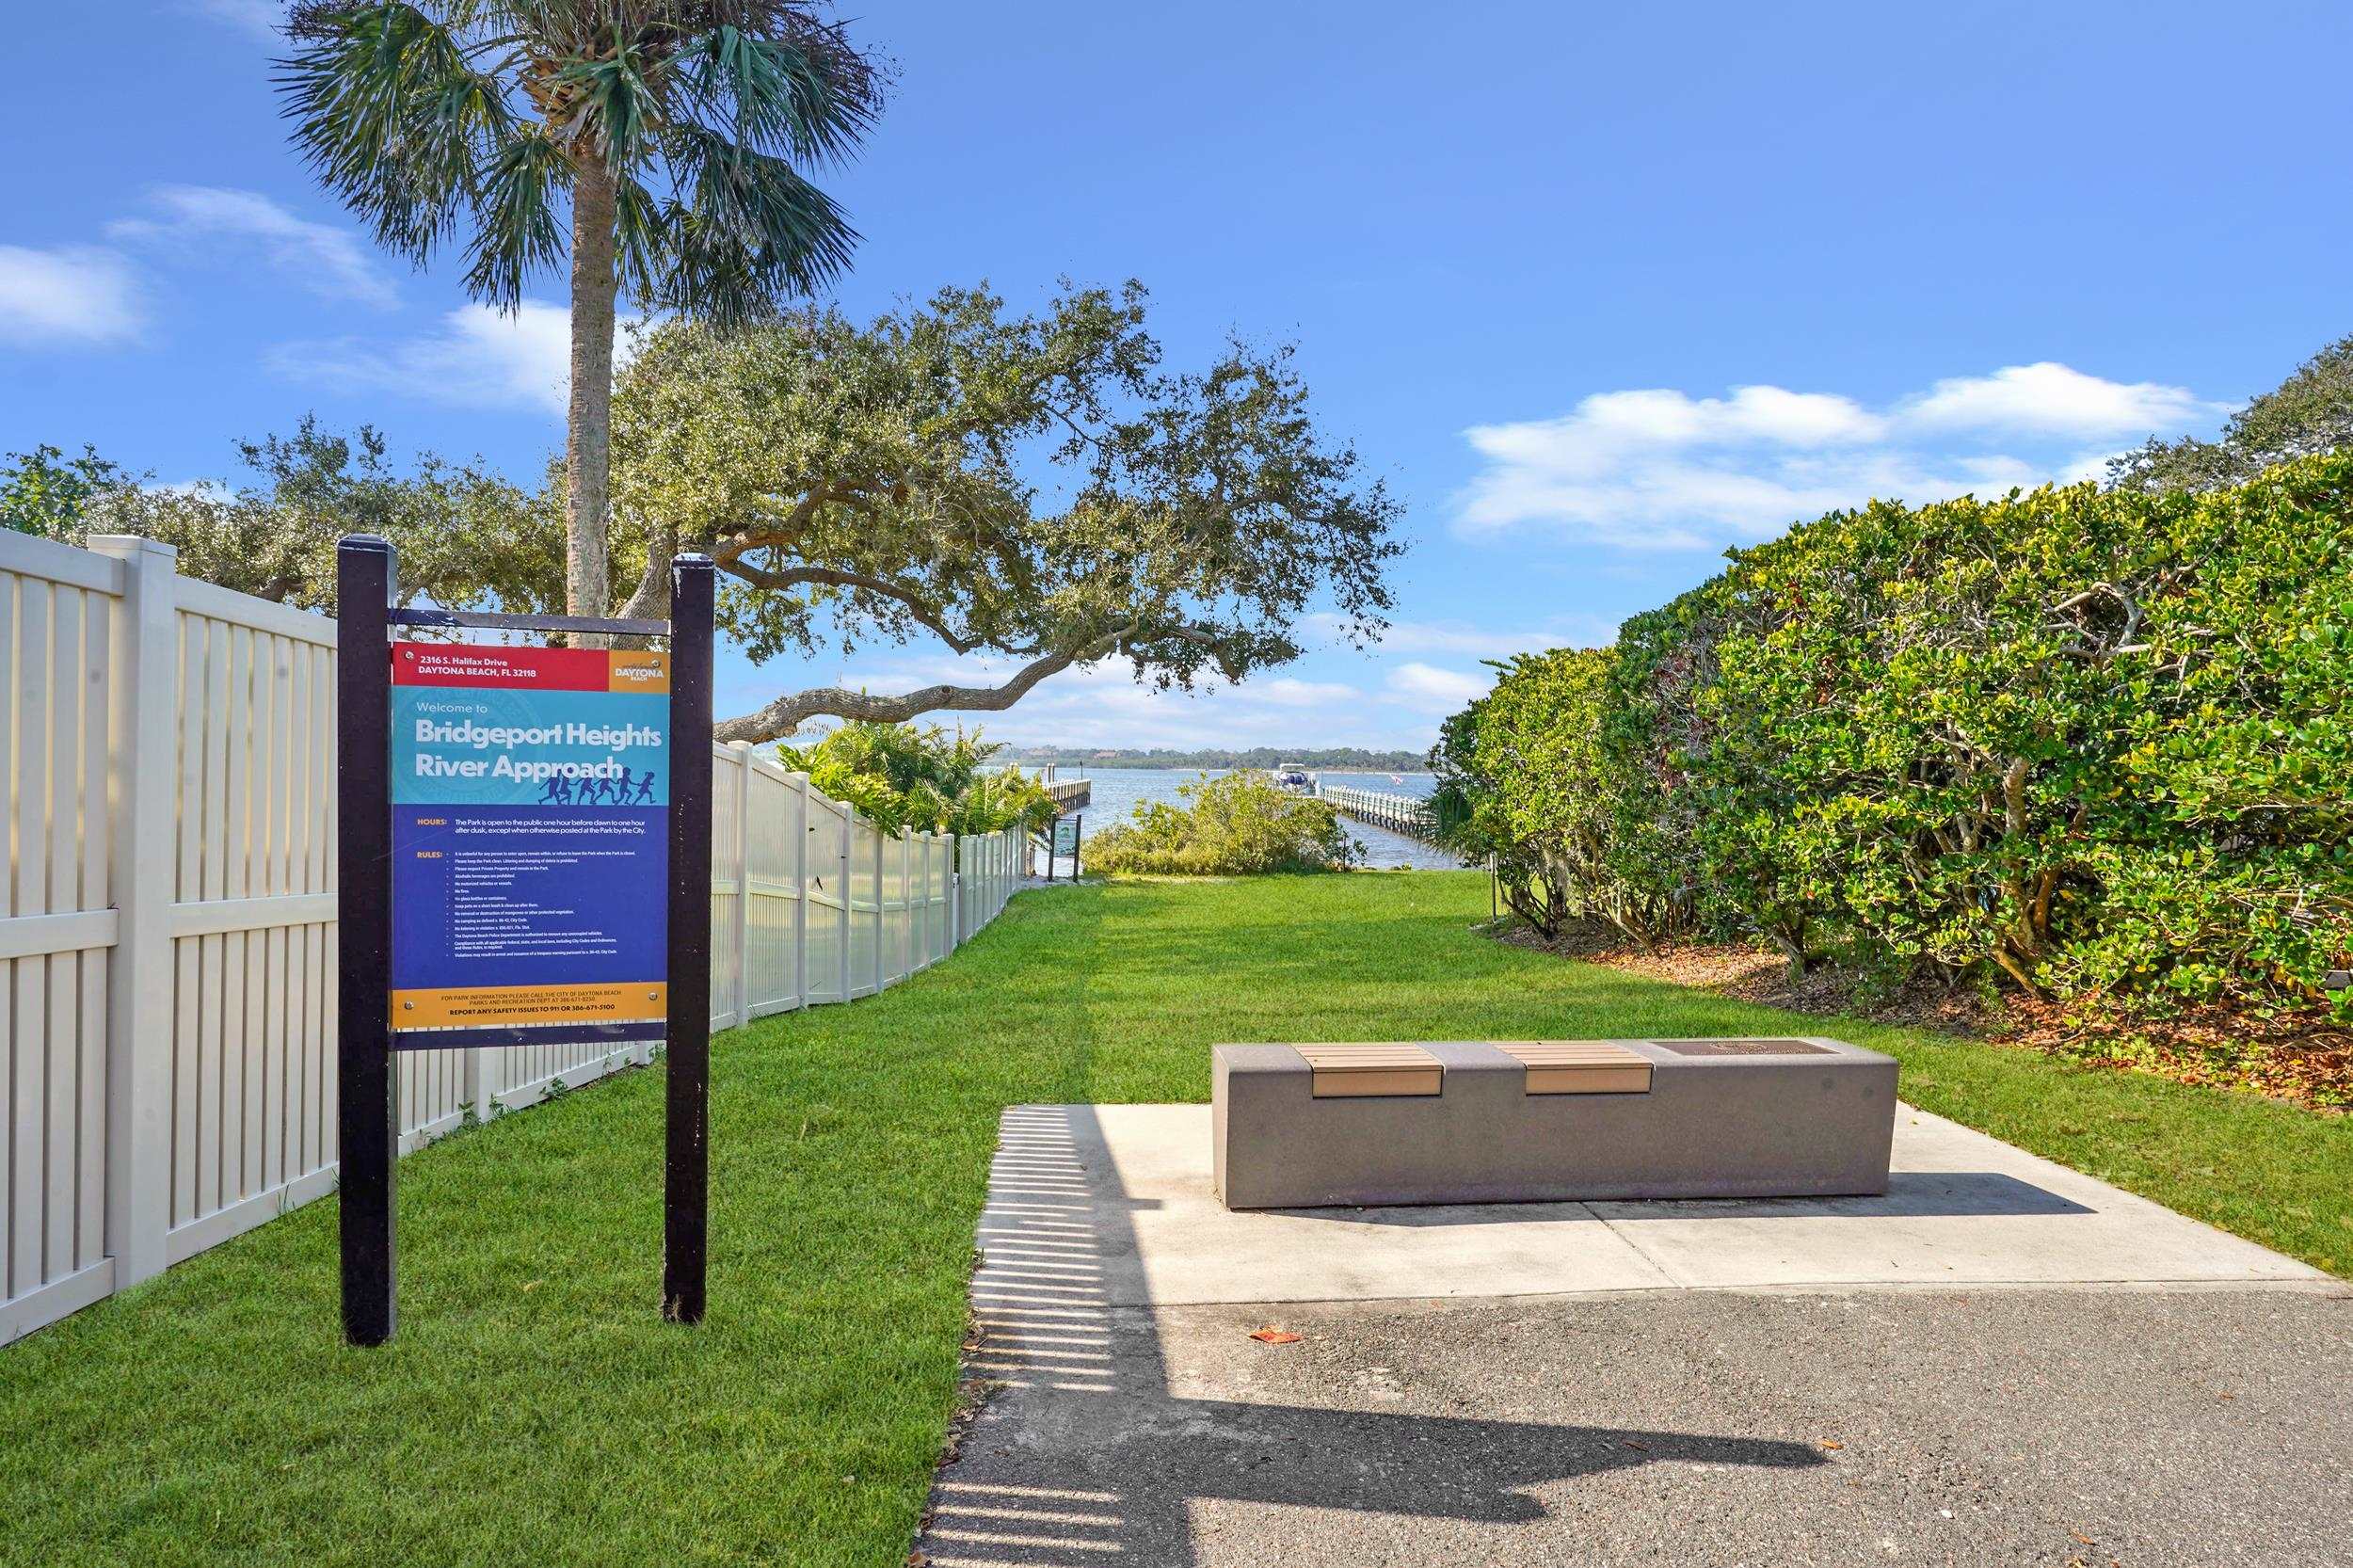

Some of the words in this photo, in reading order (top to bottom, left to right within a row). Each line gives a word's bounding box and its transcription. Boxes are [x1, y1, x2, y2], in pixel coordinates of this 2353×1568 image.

[420, 656, 441, 664] 2316
[452, 657, 483, 666] Halifax
[484, 658, 508, 667] Drive
[418, 666, 465, 676] DAYTONA
[466, 667, 500, 677] BEACH,
[513, 669, 536, 678] 32118
[615, 668, 664, 679] DAYTONA
[416, 702, 472, 713] Welcome
[476, 704, 488, 713] to
[416, 719, 563, 749] Bridgeport
[567, 723, 663, 751] Heights
[416, 754, 488, 776] River
[491, 755, 624, 784] Approach
